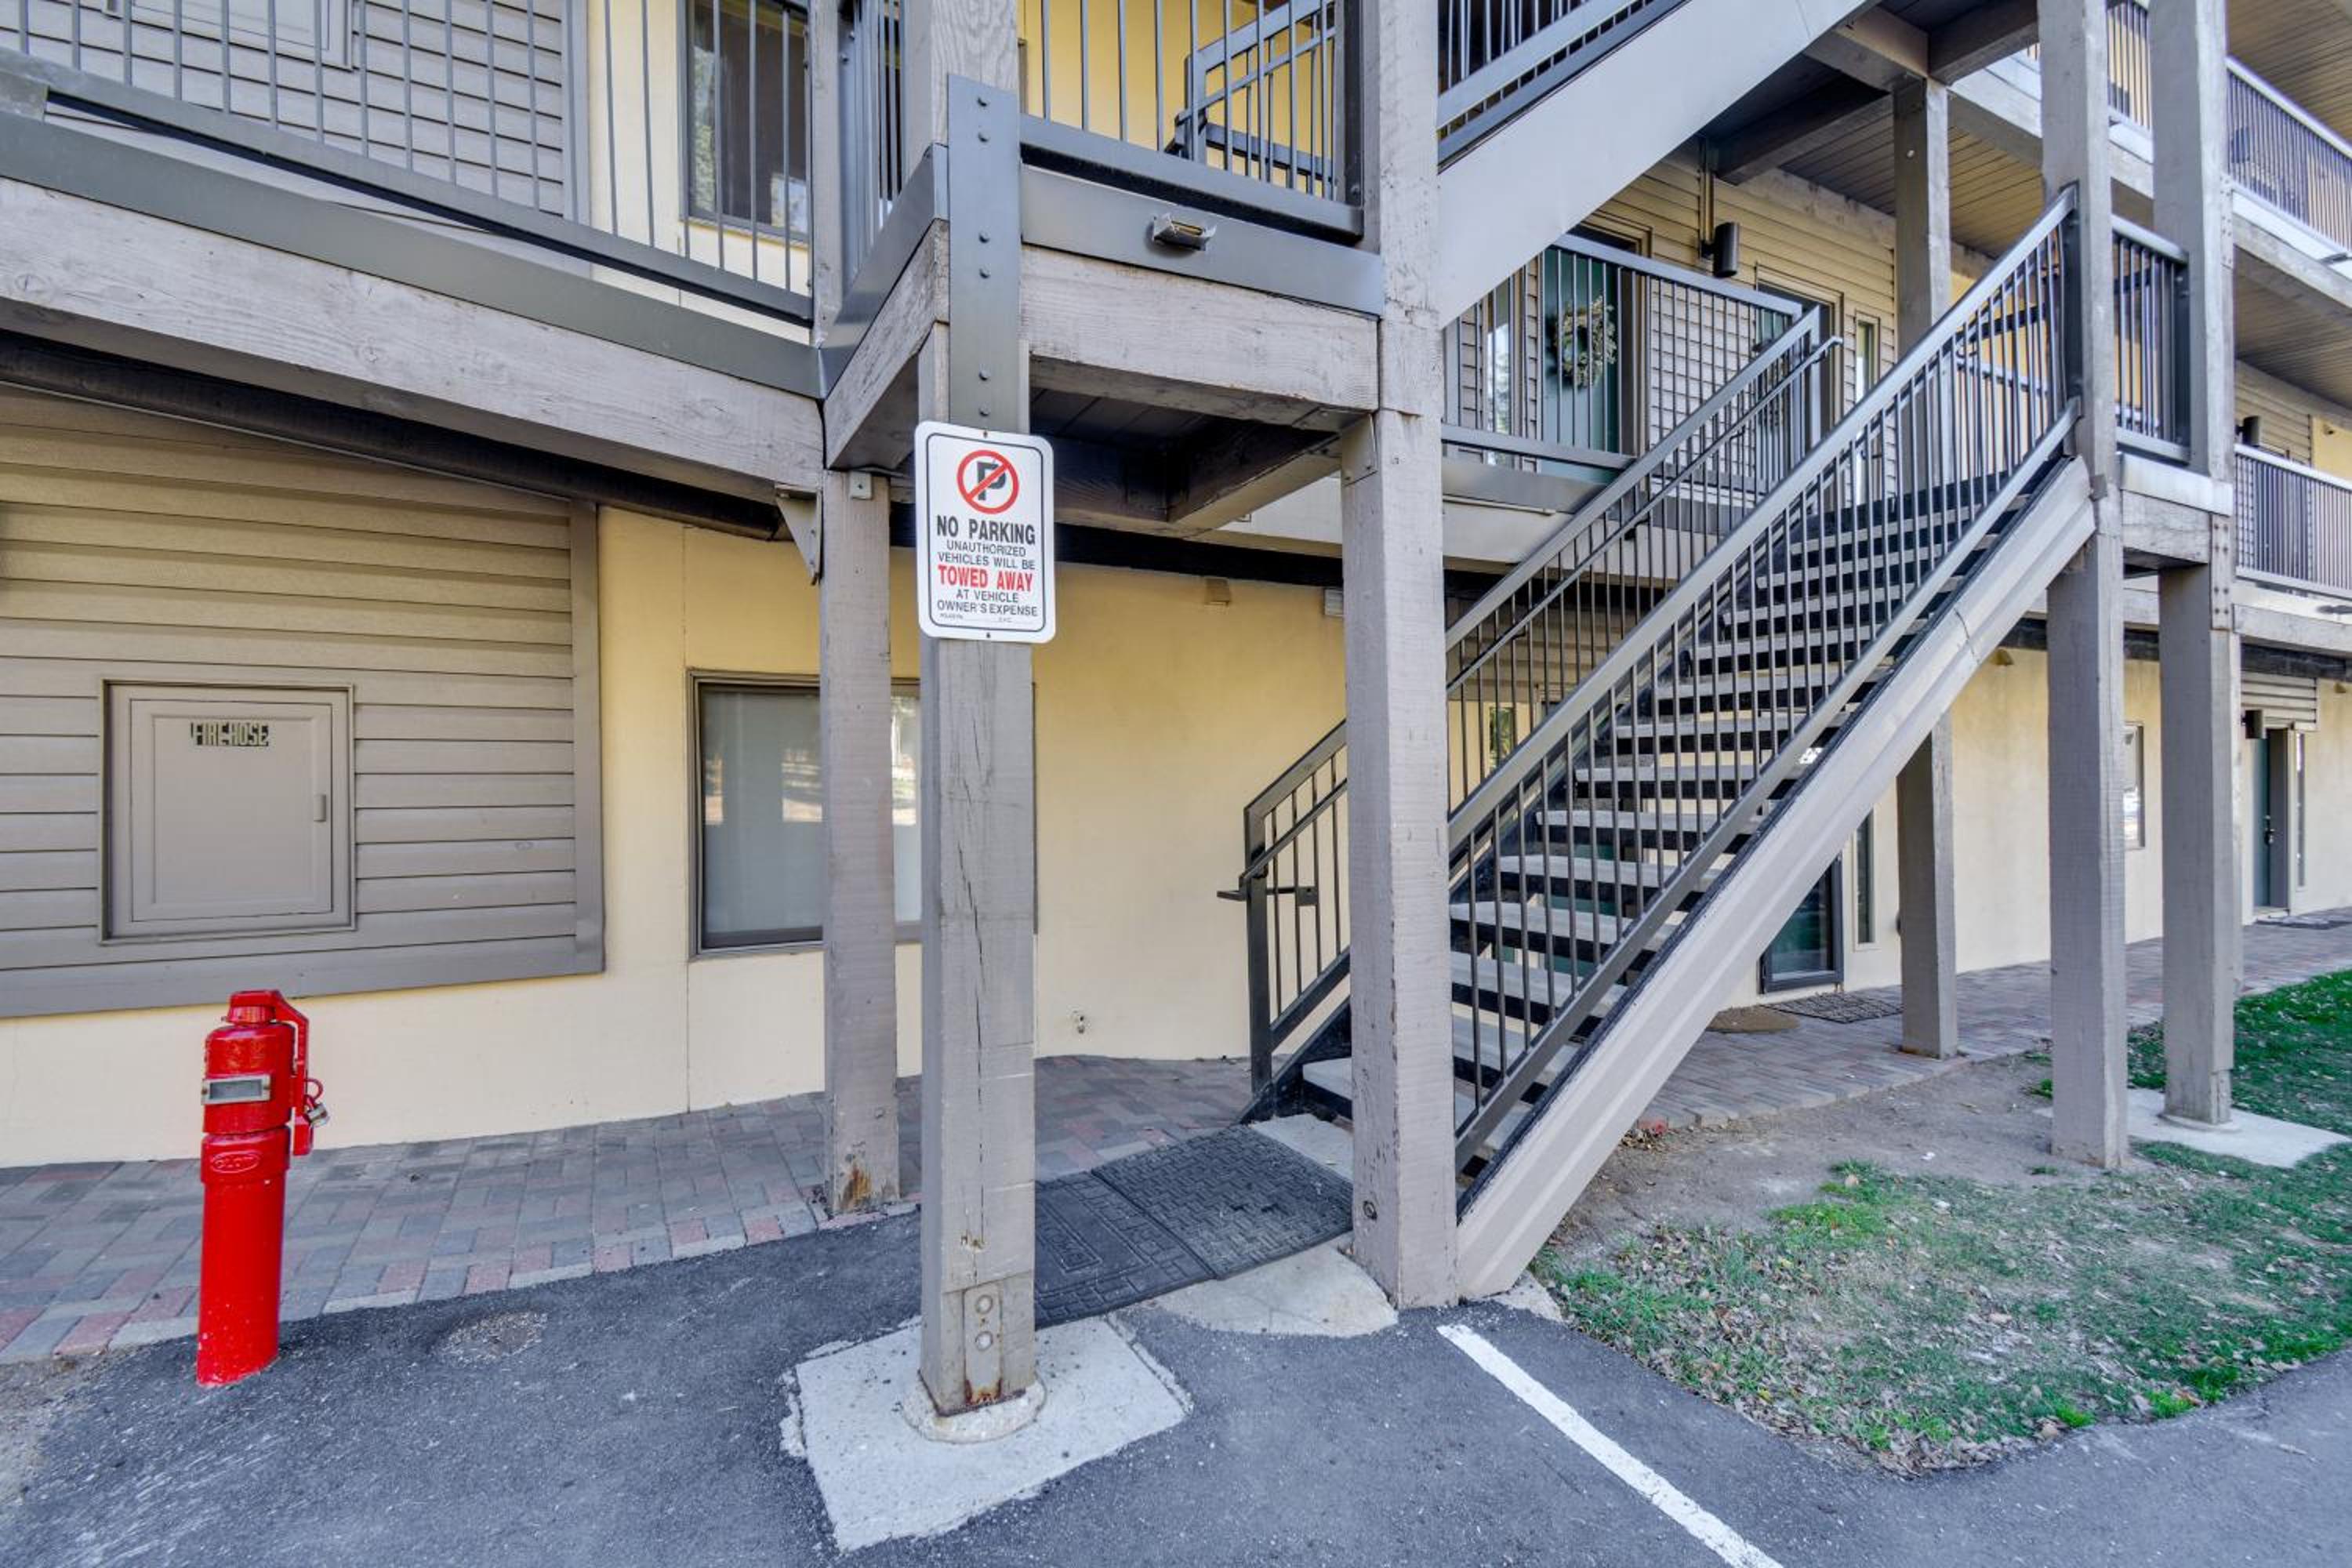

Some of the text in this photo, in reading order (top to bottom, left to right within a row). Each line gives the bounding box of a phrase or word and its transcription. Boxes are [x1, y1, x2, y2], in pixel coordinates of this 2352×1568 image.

[977, 460, 1006, 500] P
[937, 514, 1035, 545] NO PARKING
[946, 540, 1026, 557] UNAUTHORIZED
[937, 552, 1036, 569] VEHICLES WILL BE
[938, 564, 1033, 591] TOWED AWAY
[956, 589, 1018, 603] AT VEHICLE
[937, 600, 1038, 617] OWNER'S EXPENSE
